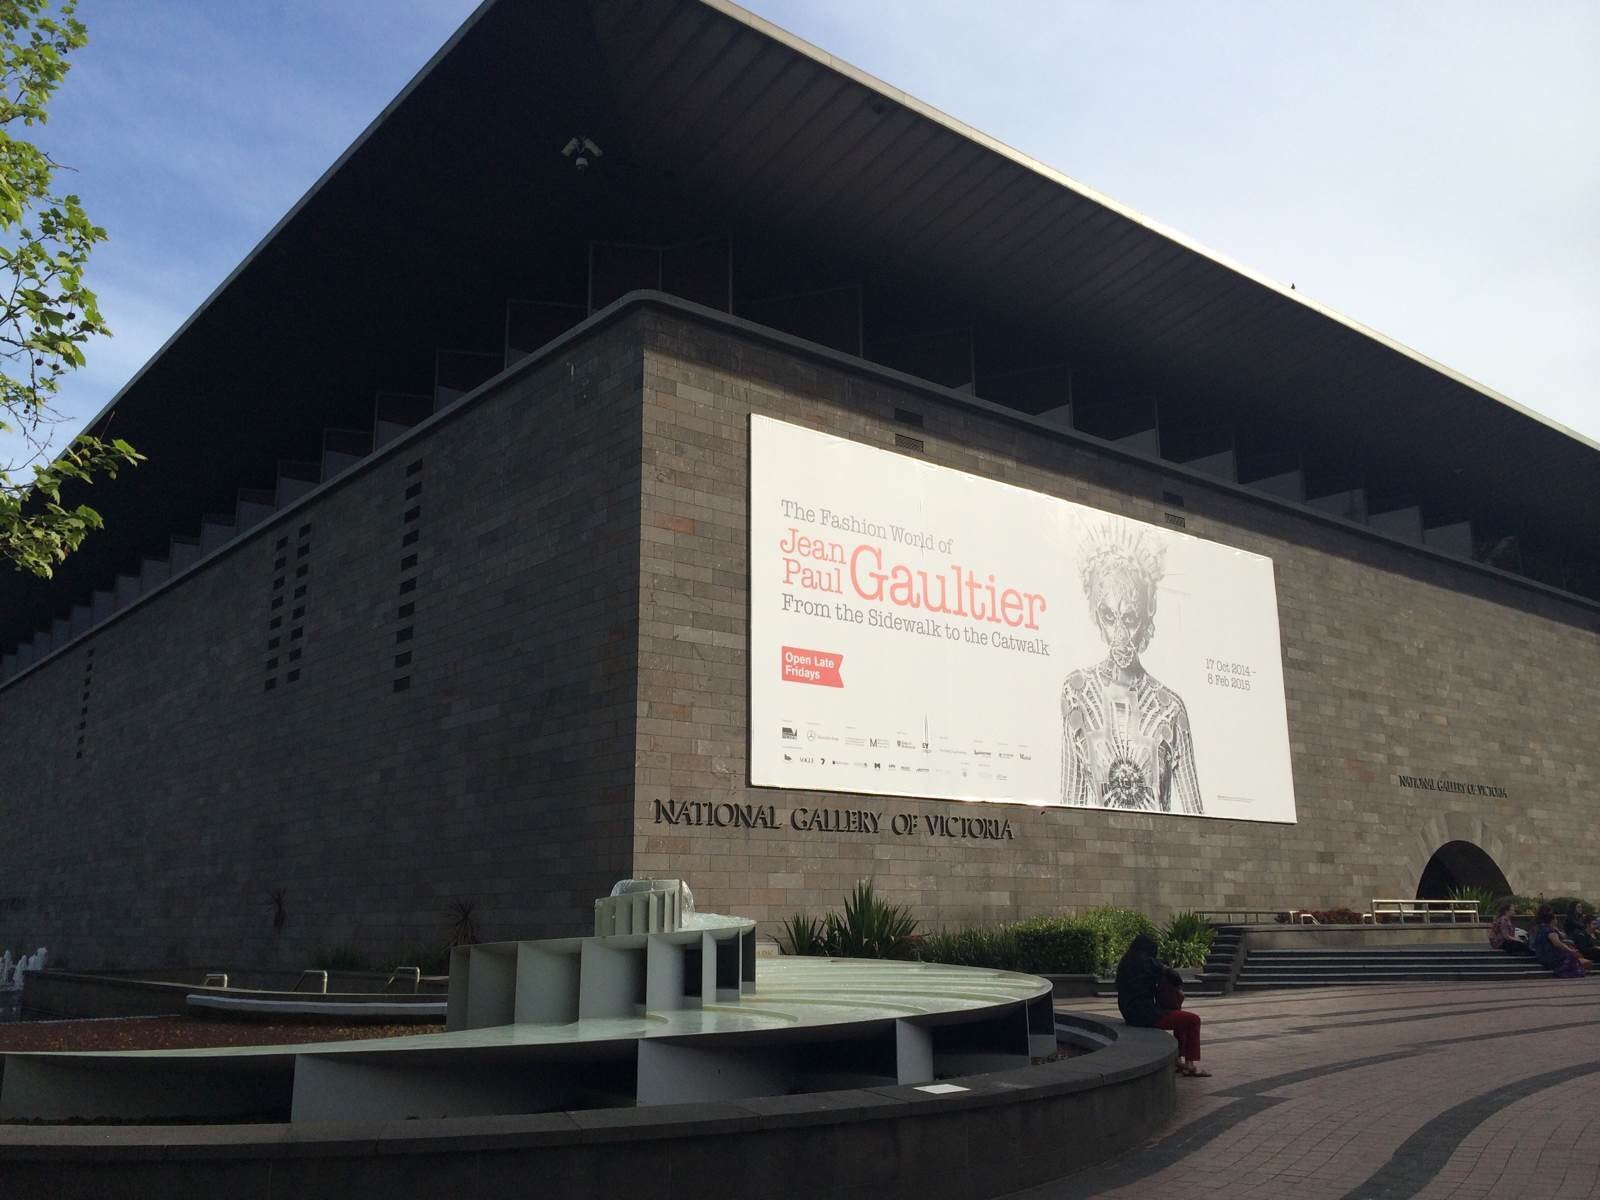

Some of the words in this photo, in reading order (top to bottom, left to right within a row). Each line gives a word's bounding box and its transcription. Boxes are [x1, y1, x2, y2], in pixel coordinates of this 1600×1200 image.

[781, 499, 815, 522] The
[820, 508, 887, 539] Fashion
[889, 524, 934, 550] World
[938, 538, 954, 554] of
[780, 528, 847, 564] Jean
[782, 557, 843, 594] Paul
[850, 544, 1046, 630] Gaultier
[781, 593, 831, 618] From
[835, 603, 863, 624] the
[868, 609, 942, 637] Sidewalk
[945, 624, 960, 641] to
[964, 626, 988, 646] the
[991, 631, 1050, 656] Catwalk
[785, 651, 811, 665] Open
[814, 656, 834, 668] Late
[785, 665, 820, 680] Fridays
[1206, 658, 1214, 670] 17
[1232, 663, 1250, 676] 2014
[1231, 677, 1250, 691] 2015
[653, 798, 782, 829] NATIONAL
[790, 808, 882, 833] GALLERY
[891, 813, 918, 836] OF
[925, 814, 1016, 840] VICTORIA
